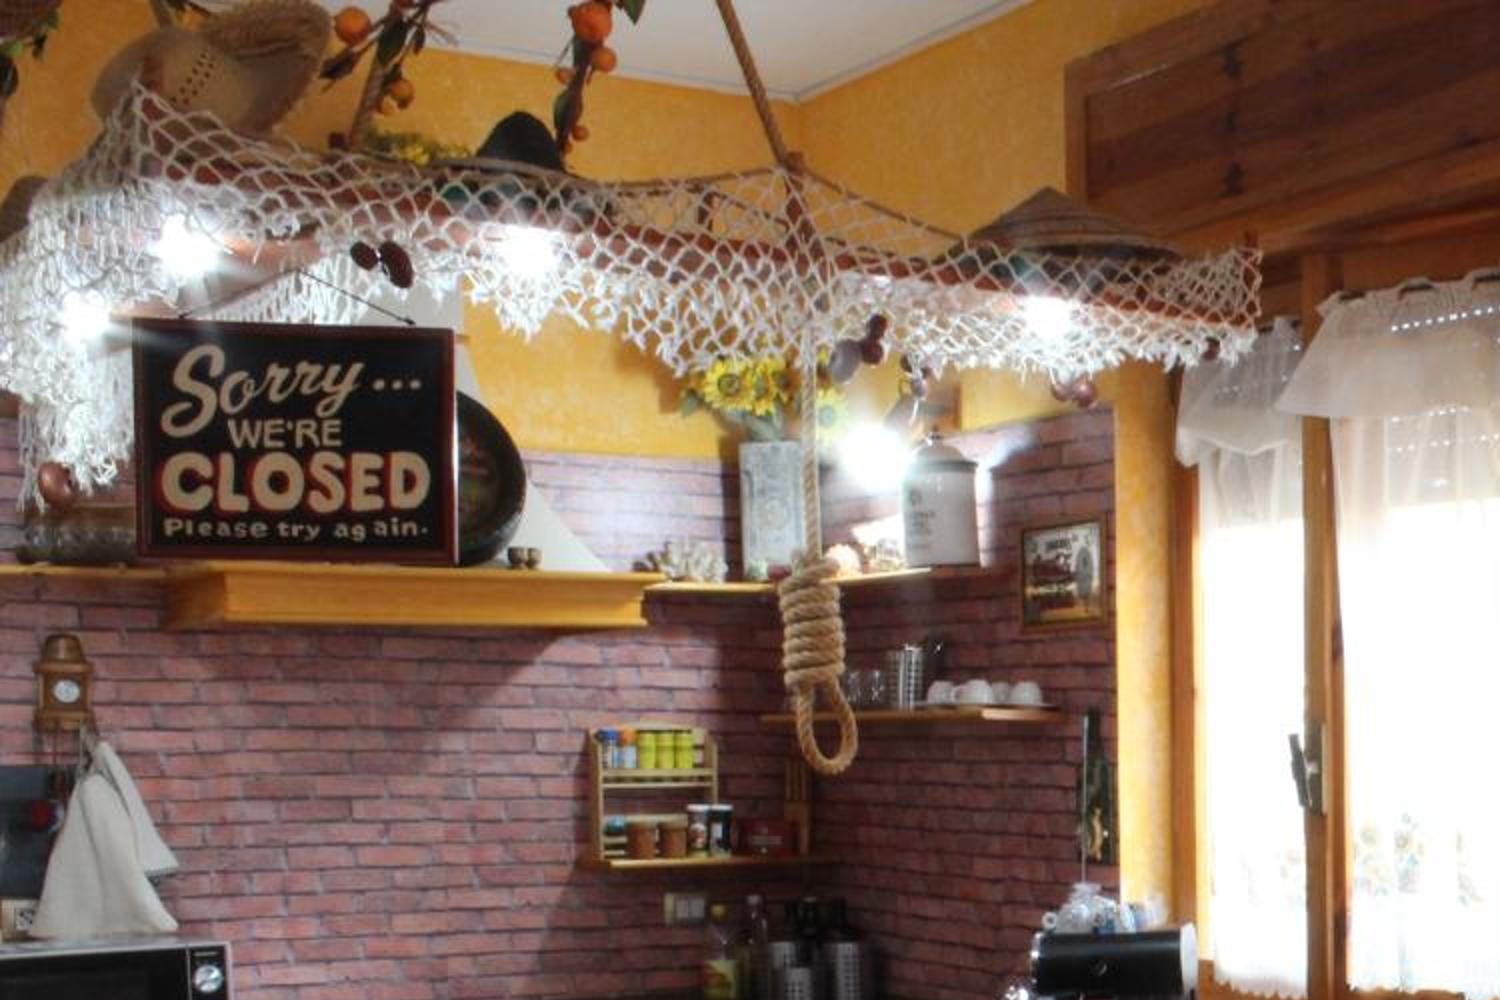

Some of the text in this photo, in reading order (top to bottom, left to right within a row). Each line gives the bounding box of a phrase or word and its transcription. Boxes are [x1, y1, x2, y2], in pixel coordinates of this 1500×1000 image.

[227, 418, 343, 449] WE'RE
[158, 451, 431, 514] CLOSED
[163, 517, 269, 538] Please
[277, 520, 321, 541] try
